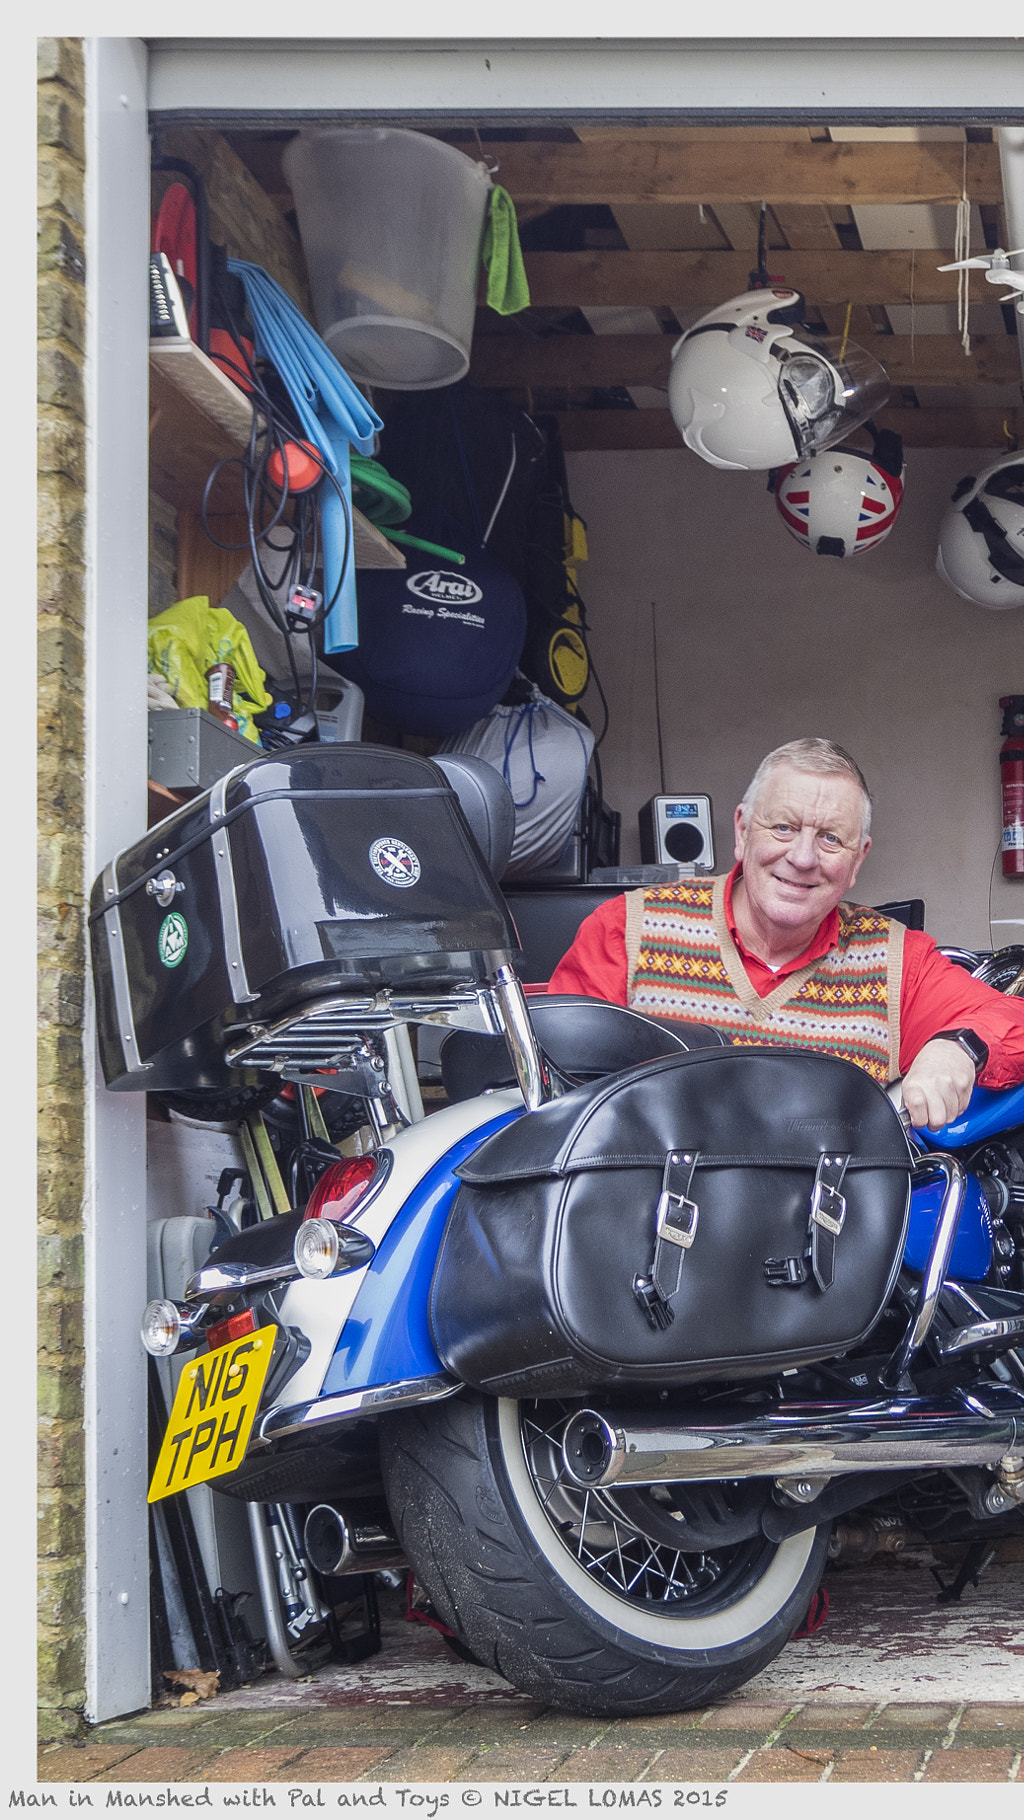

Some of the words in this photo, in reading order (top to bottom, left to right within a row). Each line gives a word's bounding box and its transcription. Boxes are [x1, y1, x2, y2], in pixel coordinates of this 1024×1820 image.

[413, 573, 476, 598] Arai
[185, 1340, 255, 1419] N16
[166, 1404, 248, 1488] TPH
